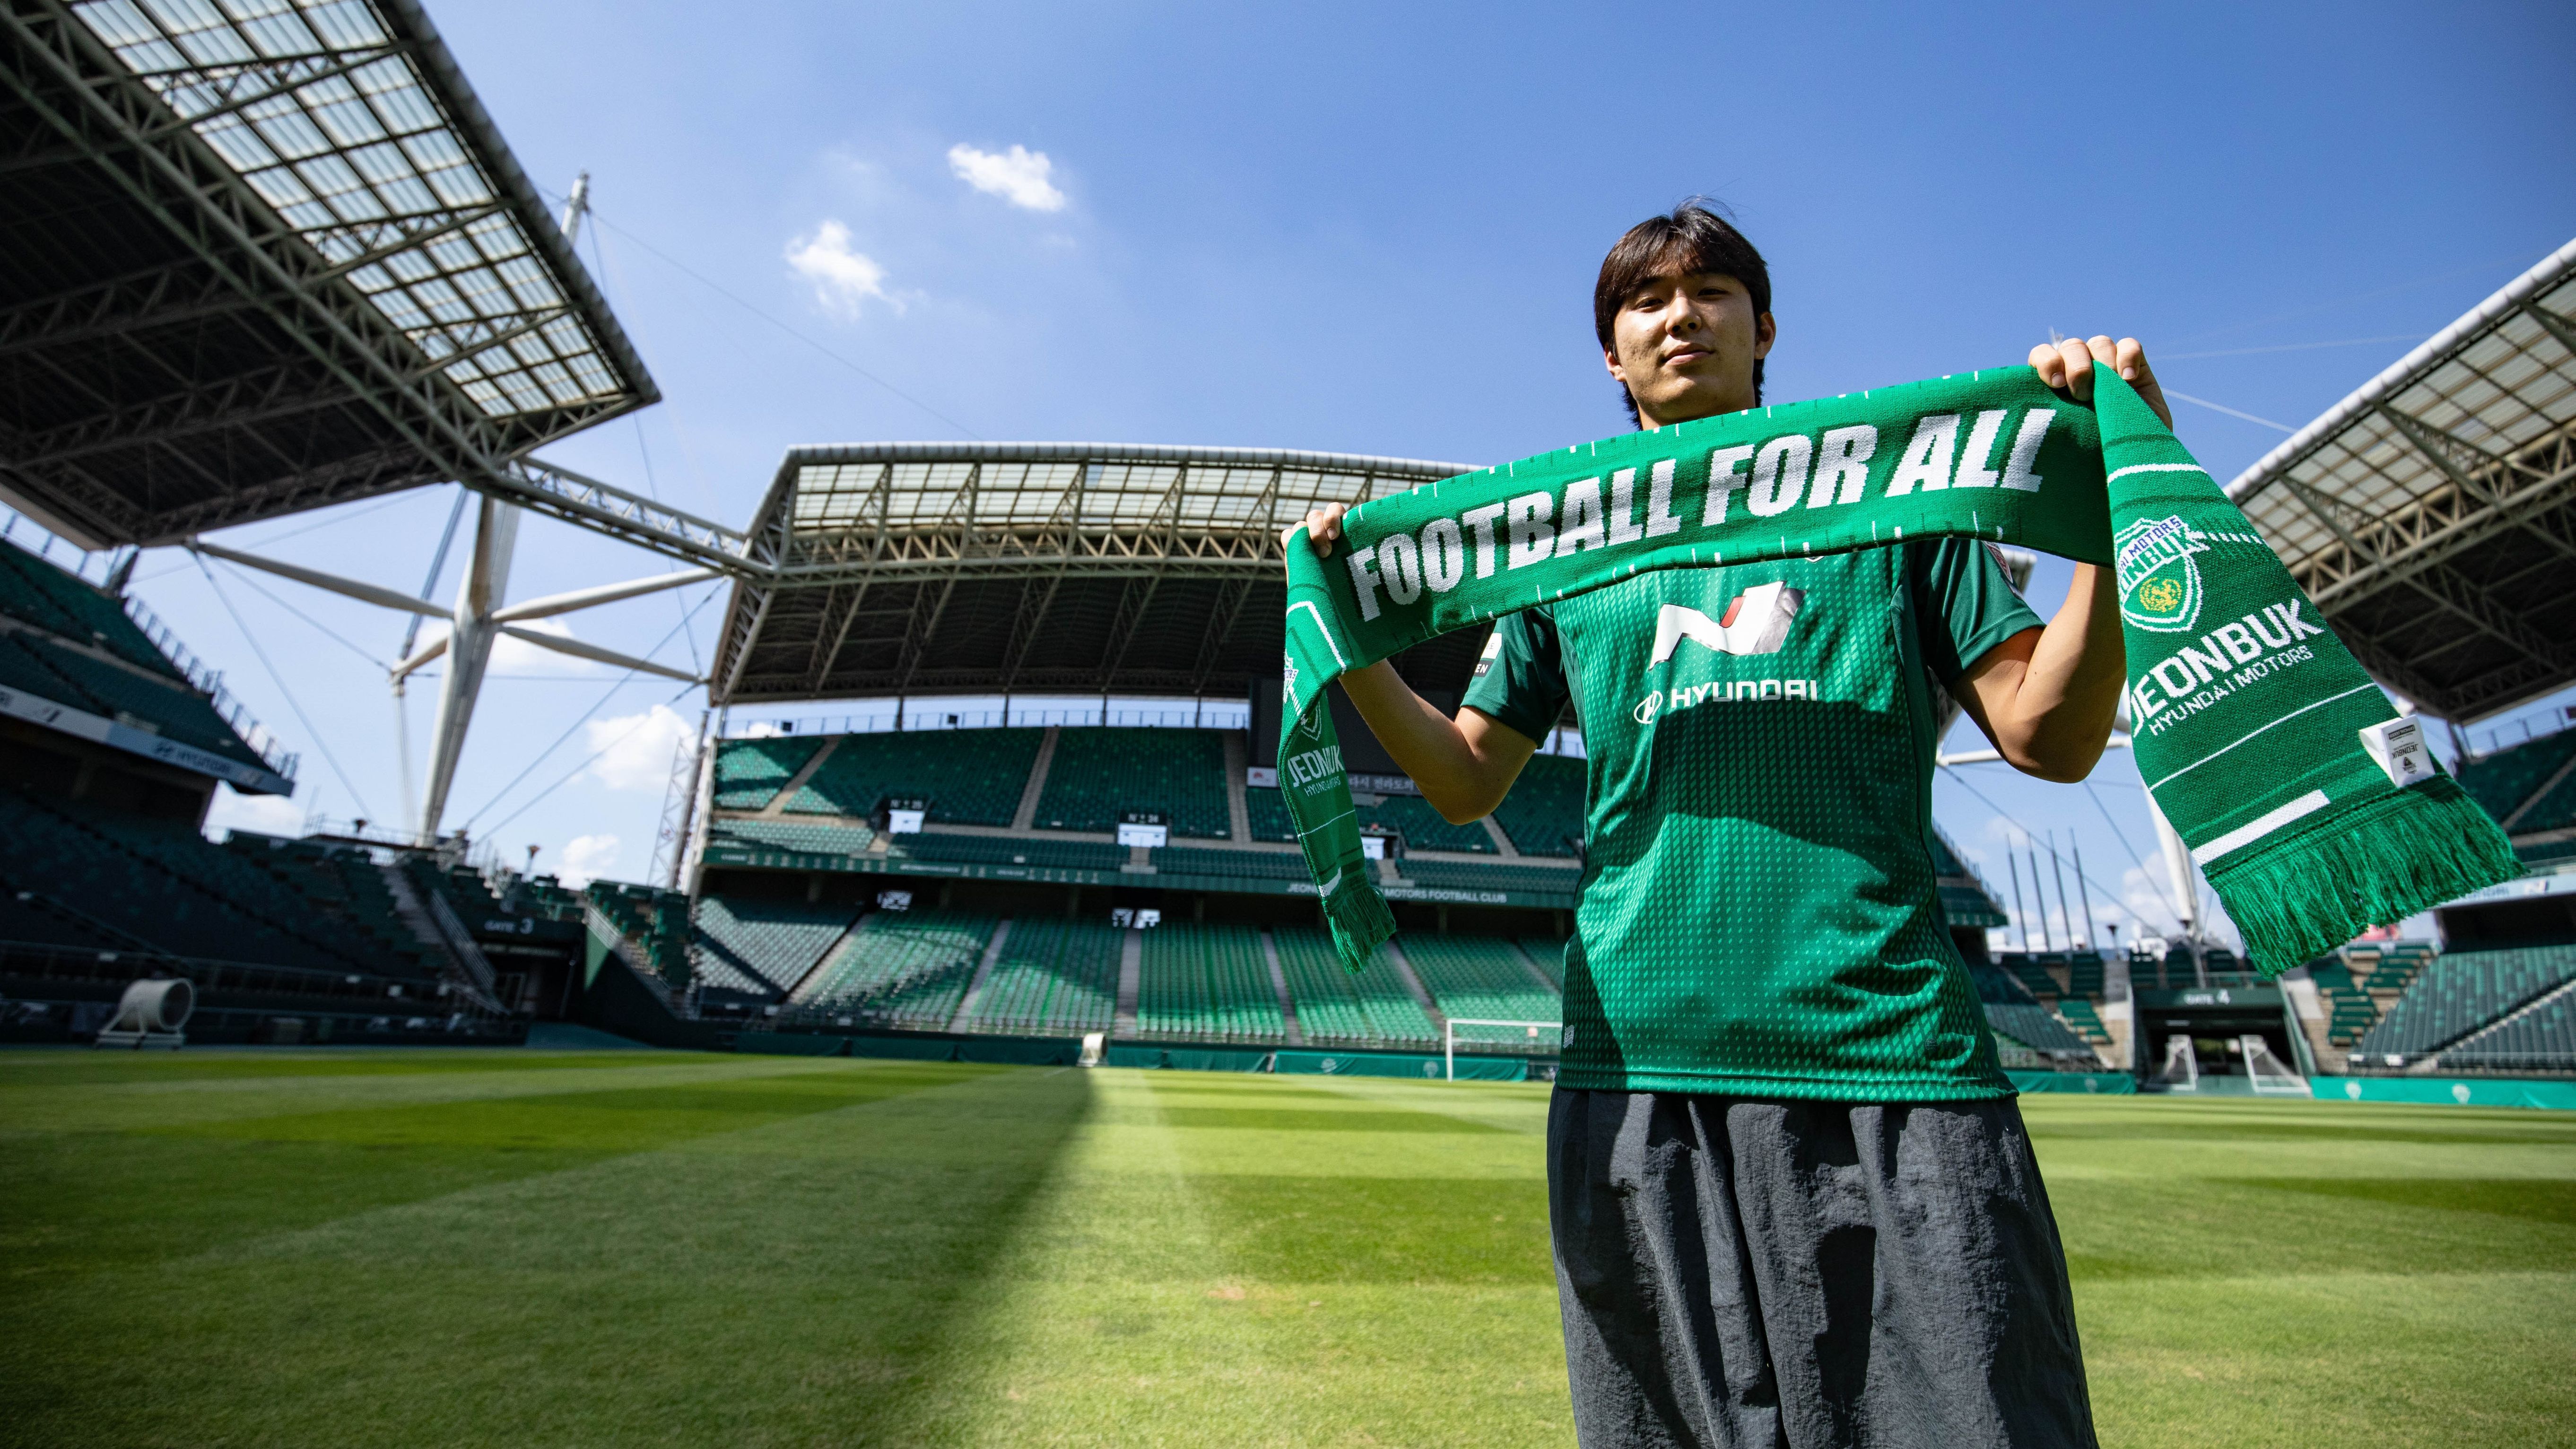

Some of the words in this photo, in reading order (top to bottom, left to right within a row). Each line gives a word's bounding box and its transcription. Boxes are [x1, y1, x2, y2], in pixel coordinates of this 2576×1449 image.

[1346, 459, 1681, 622] FOOTBALL
[1702, 425, 1878, 527] FOR
[1885, 408, 2056, 498] ALL
[2128, 517, 2182, 557] MOTORS
[2130, 598, 2325, 738] JEONBUK
[1671, 679, 1818, 709] HYUNDAI
[2148, 679, 2237, 737] HYUNDAI
[2233, 645, 2314, 688] MOTORS
[1288, 745, 1345, 788] JEONUK
[2392, 743, 2419, 760] JEONBUK
[1287, 883, 1318, 894] JEON
[1384, 887, 1427, 899] MOTORS
[1428, 889, 1479, 902] FOOTBALL
[1479, 892, 1507, 903] CLUB
